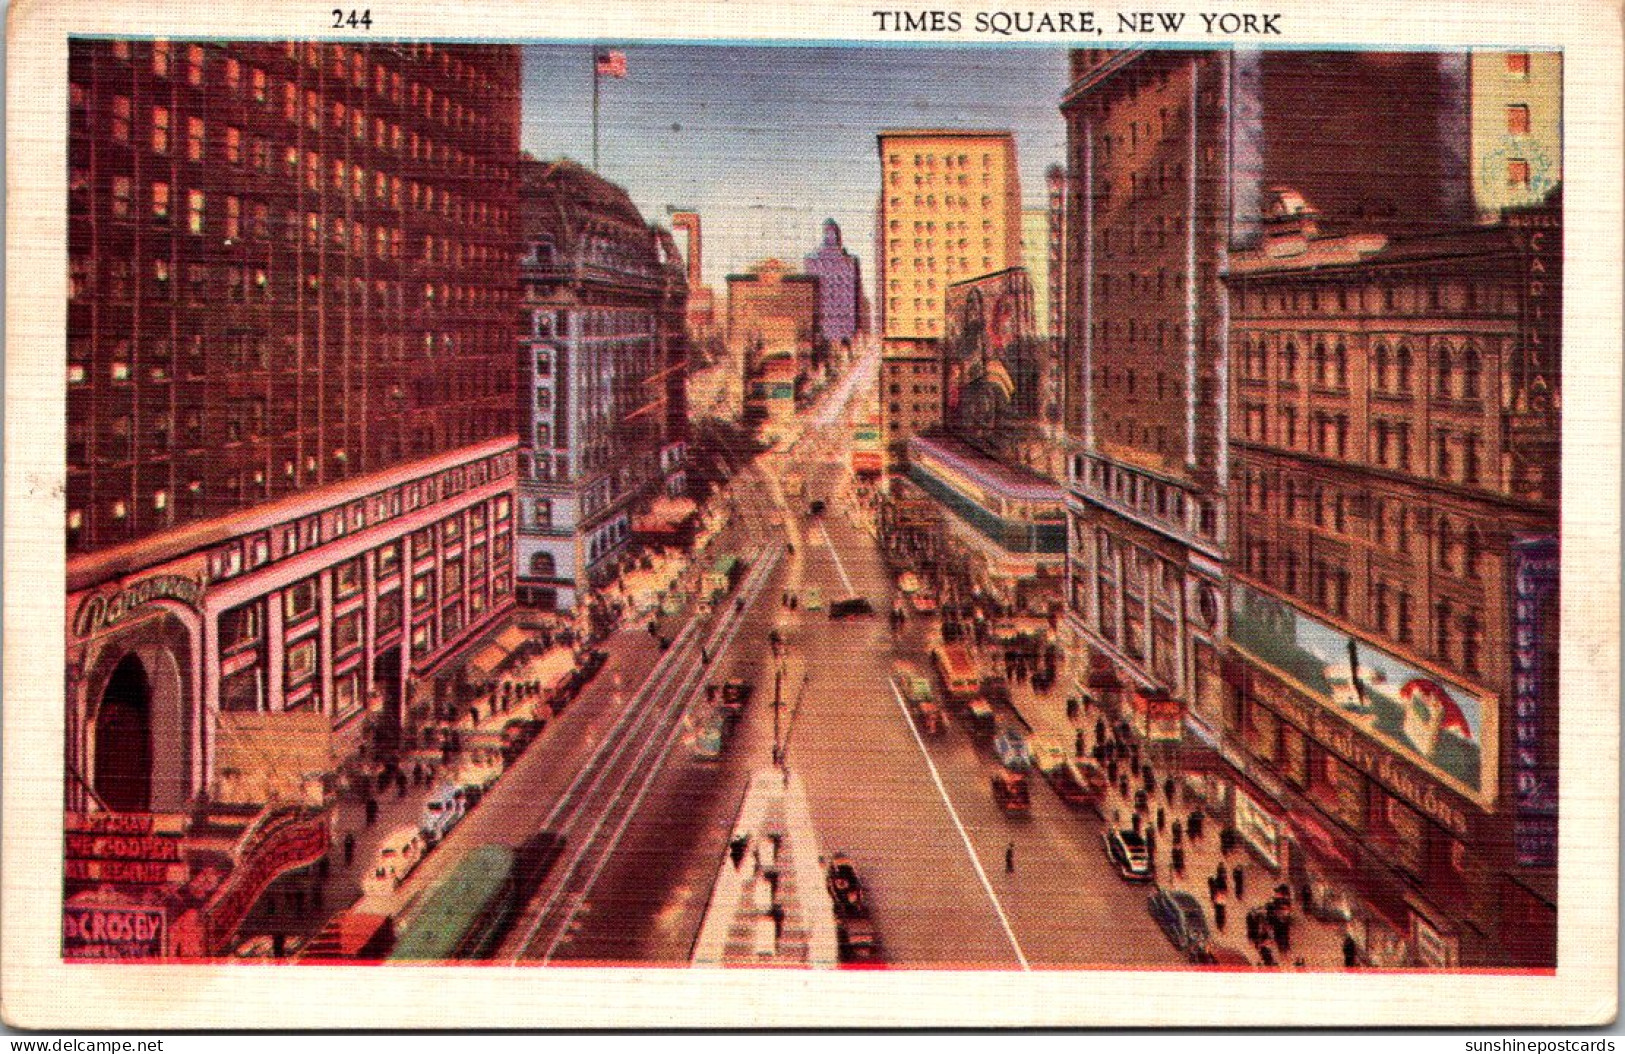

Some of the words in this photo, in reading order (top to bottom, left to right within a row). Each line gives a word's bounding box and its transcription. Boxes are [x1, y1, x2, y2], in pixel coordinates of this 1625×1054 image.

[332, 9, 372, 29] 244
[873, 12, 961, 31] TIMES
[976, 12, 1102, 35] SQUARE,
[1118, 13, 1185, 32] NEW
[1201, 13, 1280, 34] YORK
